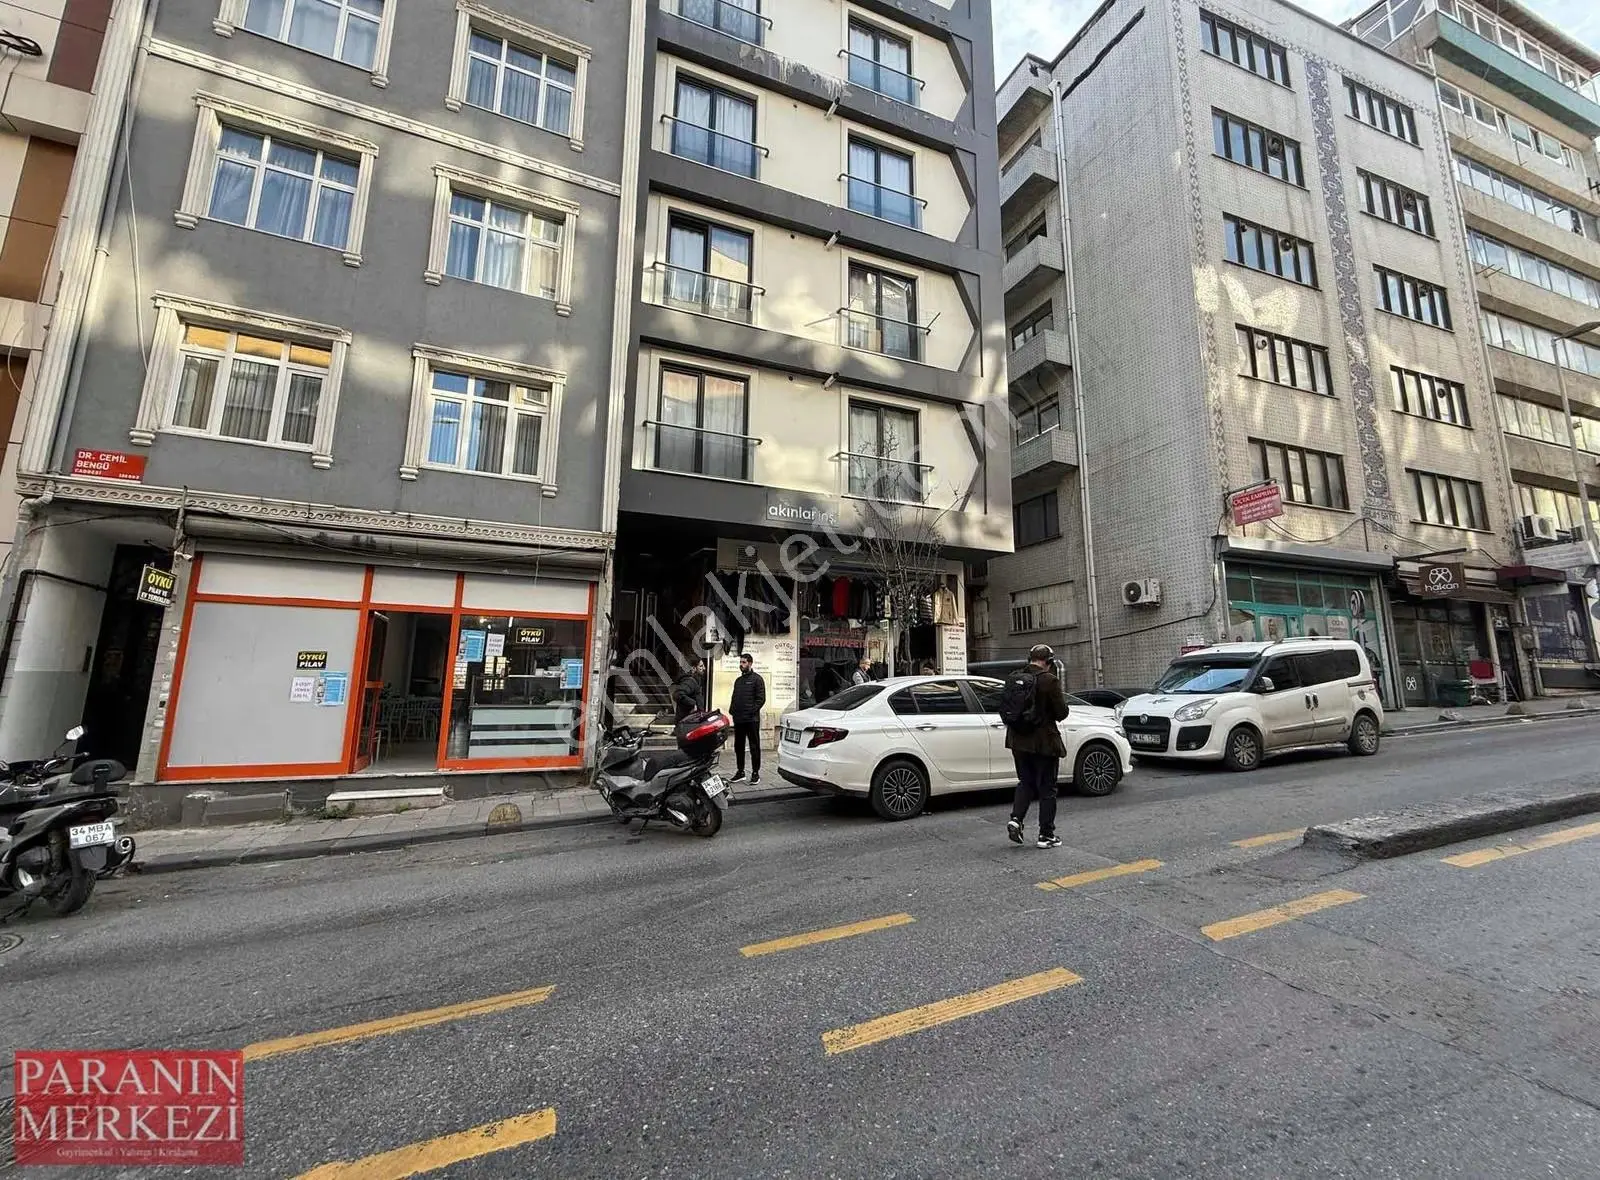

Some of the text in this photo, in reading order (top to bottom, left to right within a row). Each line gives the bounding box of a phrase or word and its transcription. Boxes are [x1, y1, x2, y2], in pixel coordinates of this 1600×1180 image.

[78, 451, 128, 464] DR. CEMİL
[76, 460, 110, 470] BENGÜ
[148, 570, 174, 590] ÖYKÜ
[1424, 582, 1460, 592] hakan
[520, 628, 542, 636] ÖYKÜ
[299, 652, 326, 661] ÖYKÜ
[71, 823, 112, 836] 34 MBA
[85, 832, 106, 843] 067
